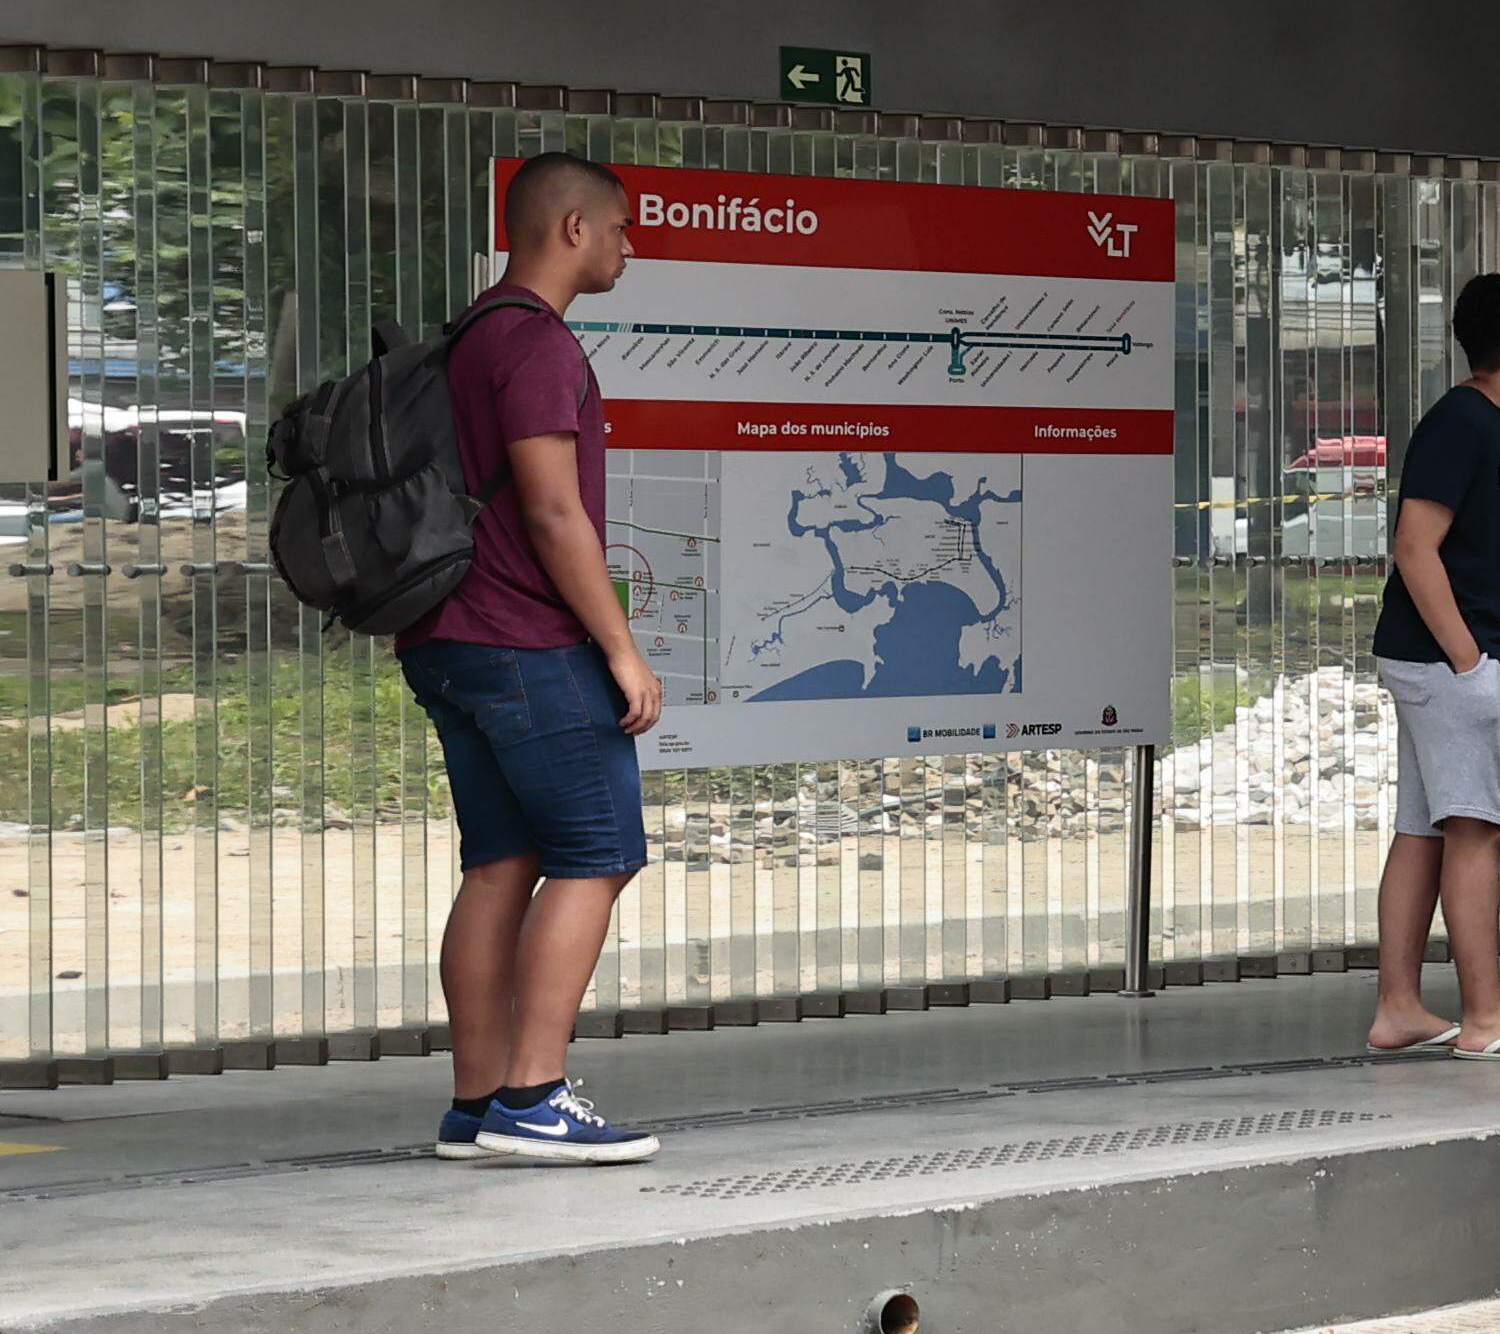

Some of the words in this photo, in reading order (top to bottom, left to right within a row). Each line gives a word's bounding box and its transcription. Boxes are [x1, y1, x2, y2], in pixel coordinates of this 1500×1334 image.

[639, 193, 819, 236] Bonifácio
[737, 421, 777, 439] Mapa
[781, 422, 807, 436] dos
[811, 422, 890, 440] municípios
[1034, 425, 1118, 441] Informações
[923, 729, 934, 738] BR
[935, 727, 981, 738] MOBILIDADE
[1021, 723, 1063, 736] ARTESP
